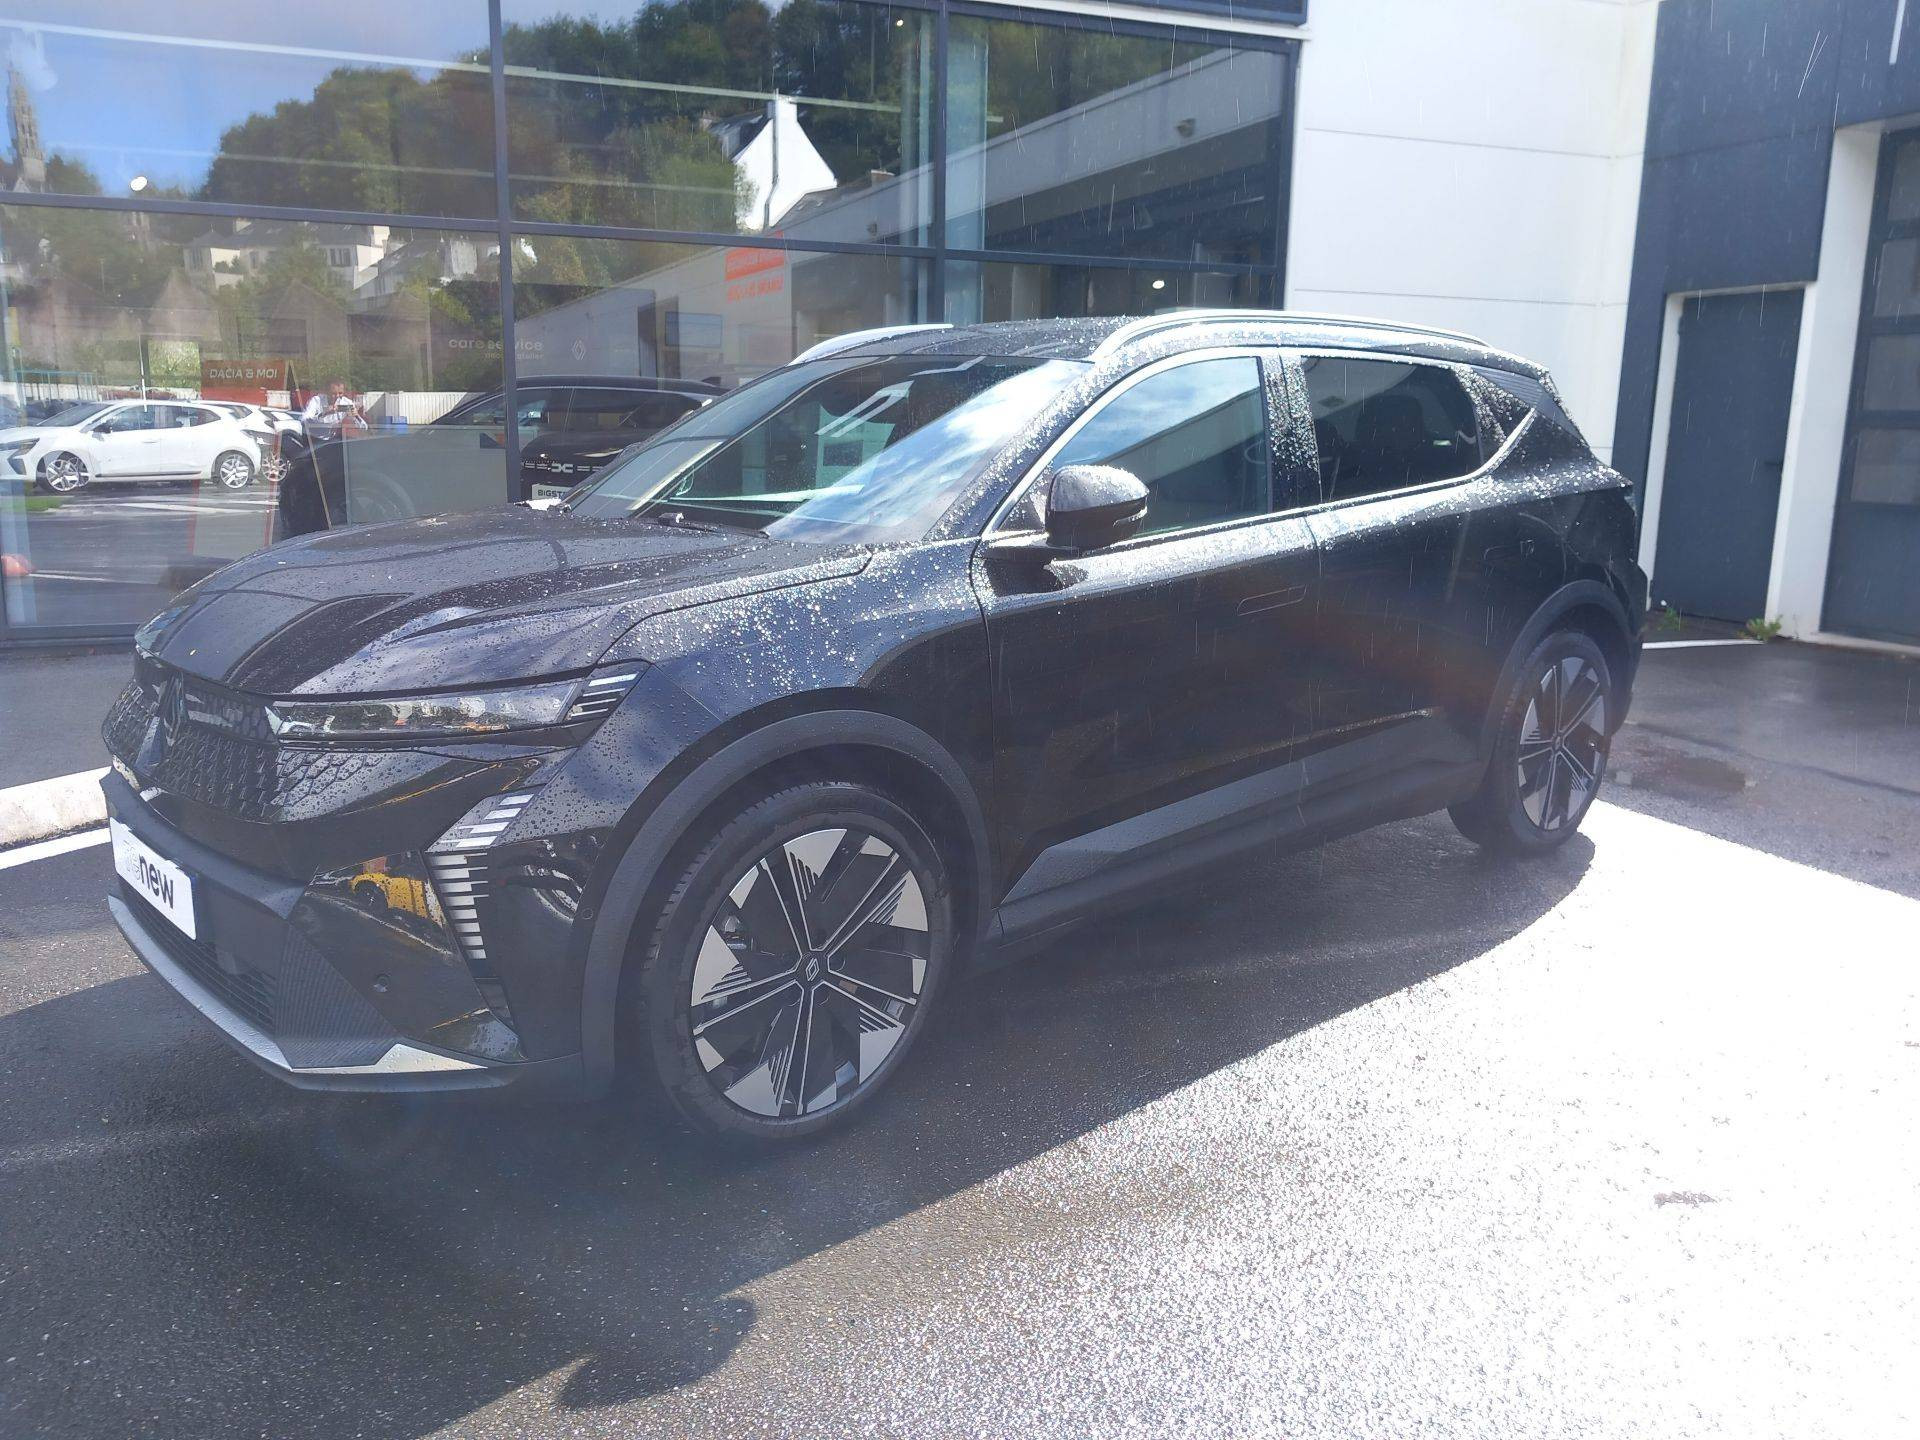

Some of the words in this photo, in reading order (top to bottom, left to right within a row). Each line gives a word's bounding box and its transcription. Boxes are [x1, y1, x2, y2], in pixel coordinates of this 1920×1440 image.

[448, 338, 485, 350] care
[487, 340, 544, 351] sevice
[209, 368, 243, 379] DACIA
[256, 368, 278, 379] MOI
[537, 489, 568, 498] BIGST
